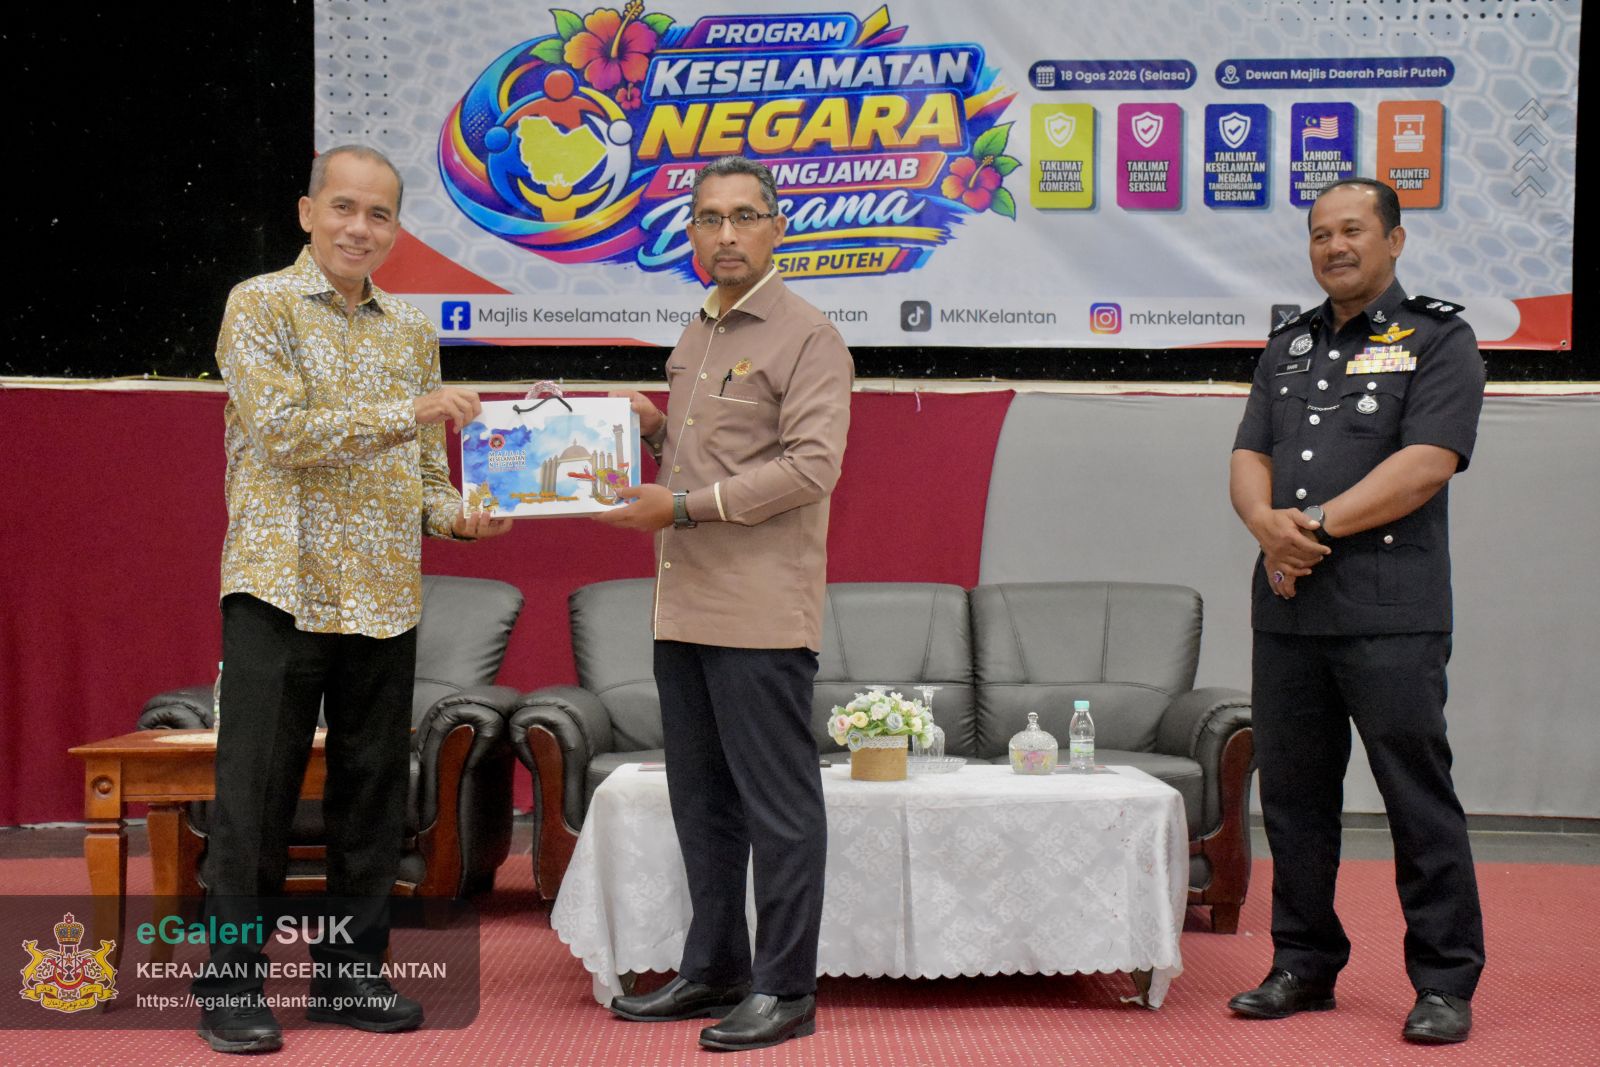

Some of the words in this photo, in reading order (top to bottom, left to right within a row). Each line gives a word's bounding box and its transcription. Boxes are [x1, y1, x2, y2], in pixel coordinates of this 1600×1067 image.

[705, 21, 847, 44] PROGRAM
[650, 51, 972, 97] KESELAMATAN
[1060, 71, 1073, 81] 18
[1075, 71, 1106, 83] Ogos
[1108, 71, 1137, 81] 2026
[1139, 70, 1191, 83] (Selasa)
[1245, 69, 1288, 80] Dewan
[1291, 68, 1327, 82] Majlis
[1329, 68, 1374, 79] Daerah
[1377, 67, 1408, 78] Pasir
[1411, 67, 1446, 78] Puteh
[637, 93, 963, 159] NEGARA
[1215, 152, 1257, 161] TAKLIMAT
[1303, 151, 1342, 161] KAHOOT!
[1040, 161, 1082, 171] TAKLIMAT
[1127, 161, 1169, 171] TAKLIMAT
[1205, 162, 1265, 172] KESELAMATAN
[1291, 162, 1352, 171] KESELAMATAN
[667, 157, 919, 190] TANGJAWAB
[1042, 171, 1080, 181] JENAYAH
[1129, 171, 1167, 181] JENAYAH
[1218, 173, 1252, 182] NEGARA
[1304, 172, 1339, 181] NEGARA
[1390, 168, 1430, 179] KAUNTER
[1040, 181, 1083, 192] KOMERSIL
[1129, 181, 1167, 192] SEKSUAL
[1214, 191, 1256, 201] BERSAMA
[822, 251, 884, 270] PUTEH
[478, 308, 528, 327] Majlis
[533, 308, 651, 323] Keselamatan
[940, 308, 1057, 324] MKNKelantan
[1130, 310, 1245, 326] mknkelantan
